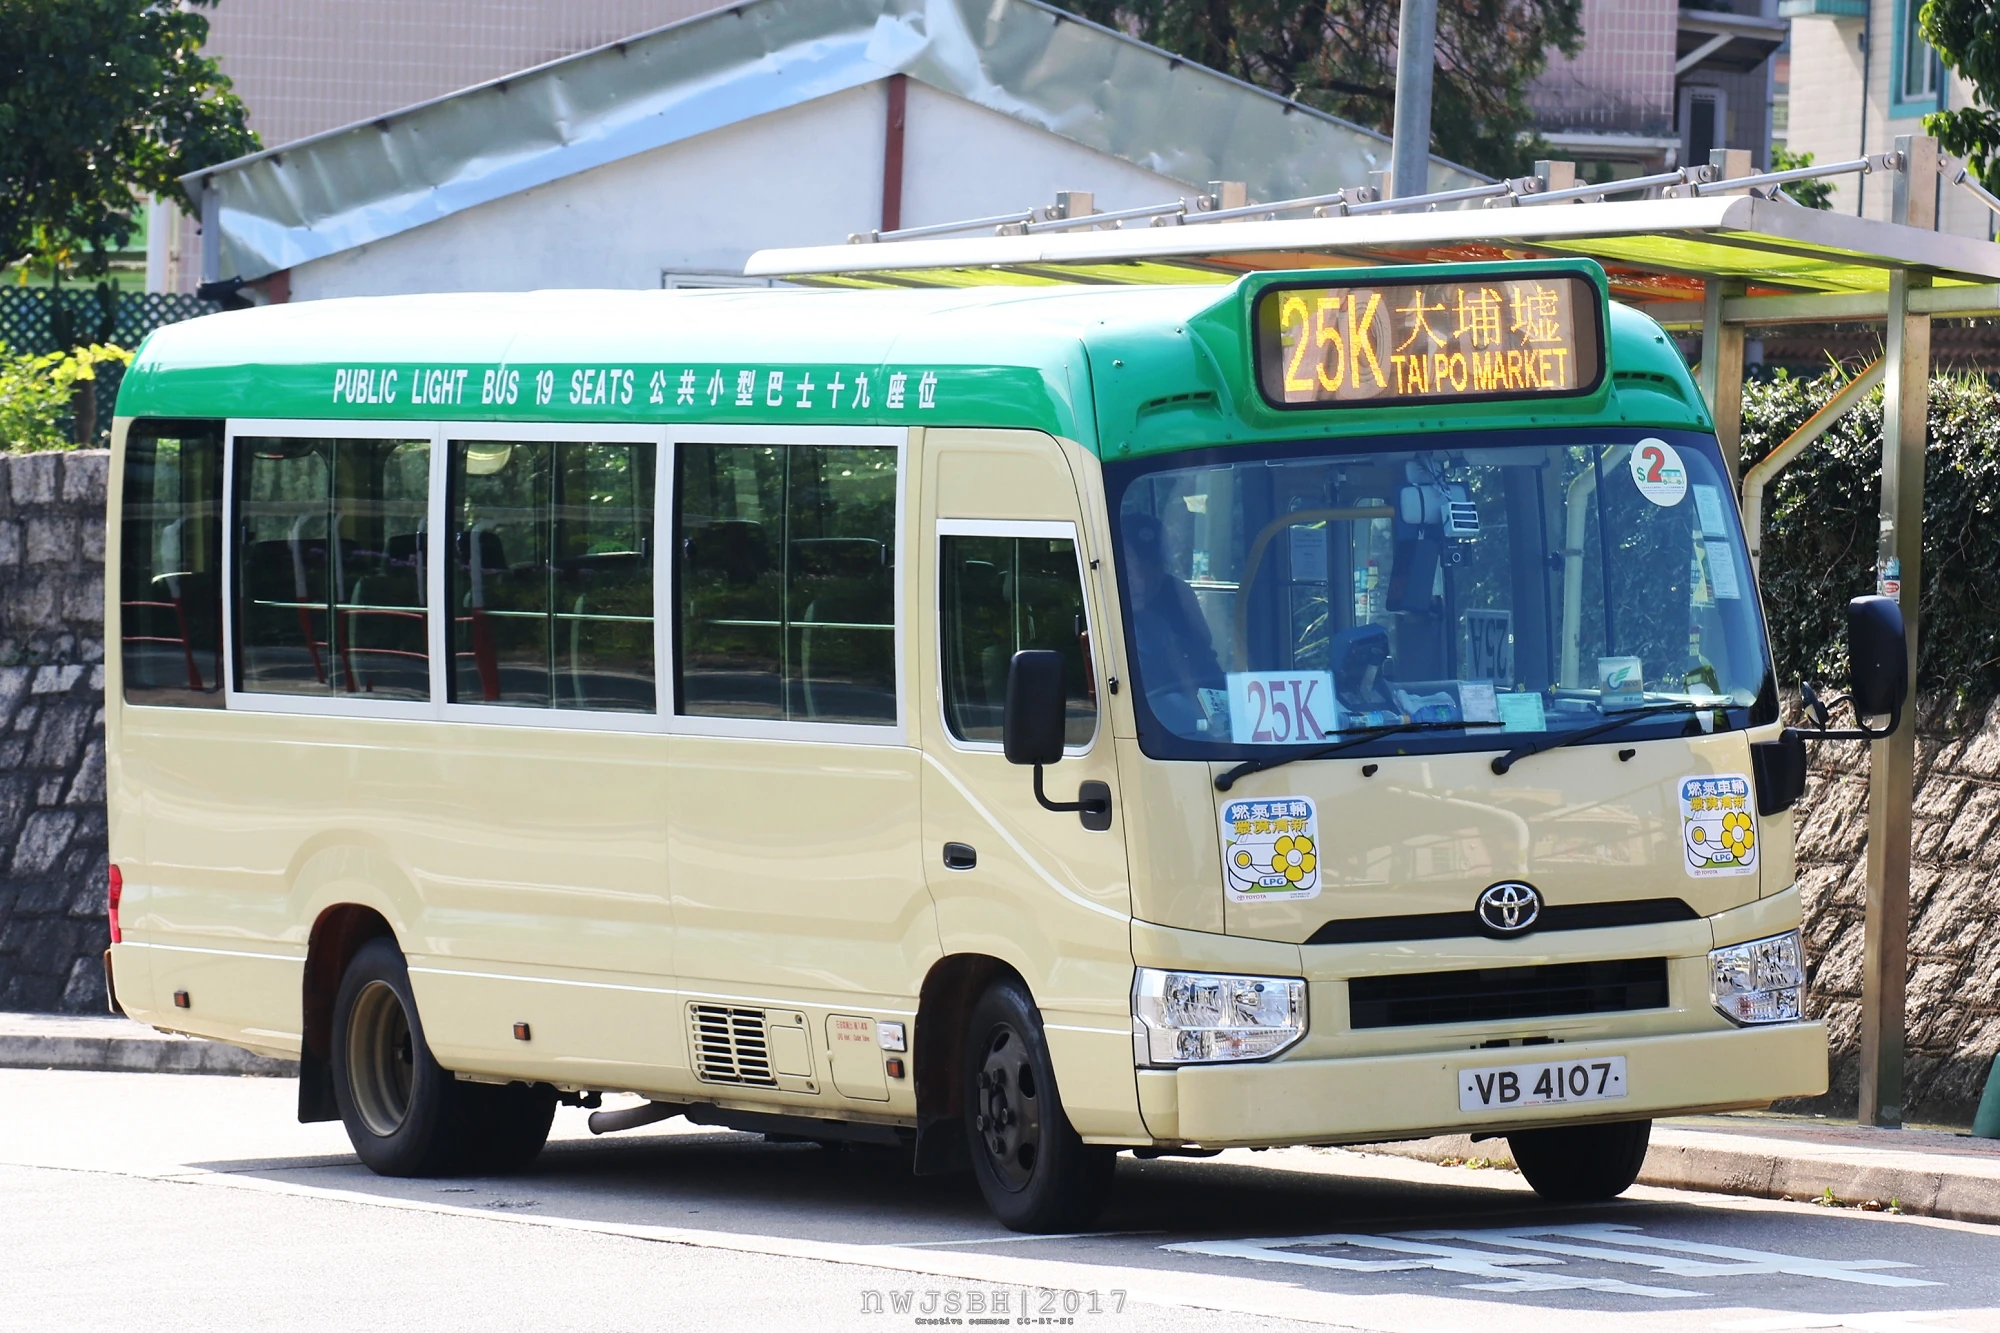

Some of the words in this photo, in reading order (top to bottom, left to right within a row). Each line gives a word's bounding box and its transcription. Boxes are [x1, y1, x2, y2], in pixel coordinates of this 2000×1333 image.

[1395, 285, 1562, 352] 大埔墟
[1281, 293, 1388, 392] 25K
[333, 369, 398, 404] PUBLIC
[411, 369, 468, 405] LIGHT
[482, 369, 520, 405] BUS
[535, 369, 554, 405] 19
[569, 369, 635, 405] SEATS
[649, 369, 939, 410] 公共小型巴士十九座位
[1390, 355, 1429, 394] TAI
[1434, 352, 1468, 392] PO
[1472, 348, 1568, 391] MARKET
[1247, 680, 1327, 743] 25K
[1715, 853, 1731, 861] LPG
[1263, 877, 1284, 886] LPG
[1474, 1071, 1521, 1105] VB
[1532, 1063, 1612, 1099] 4107
